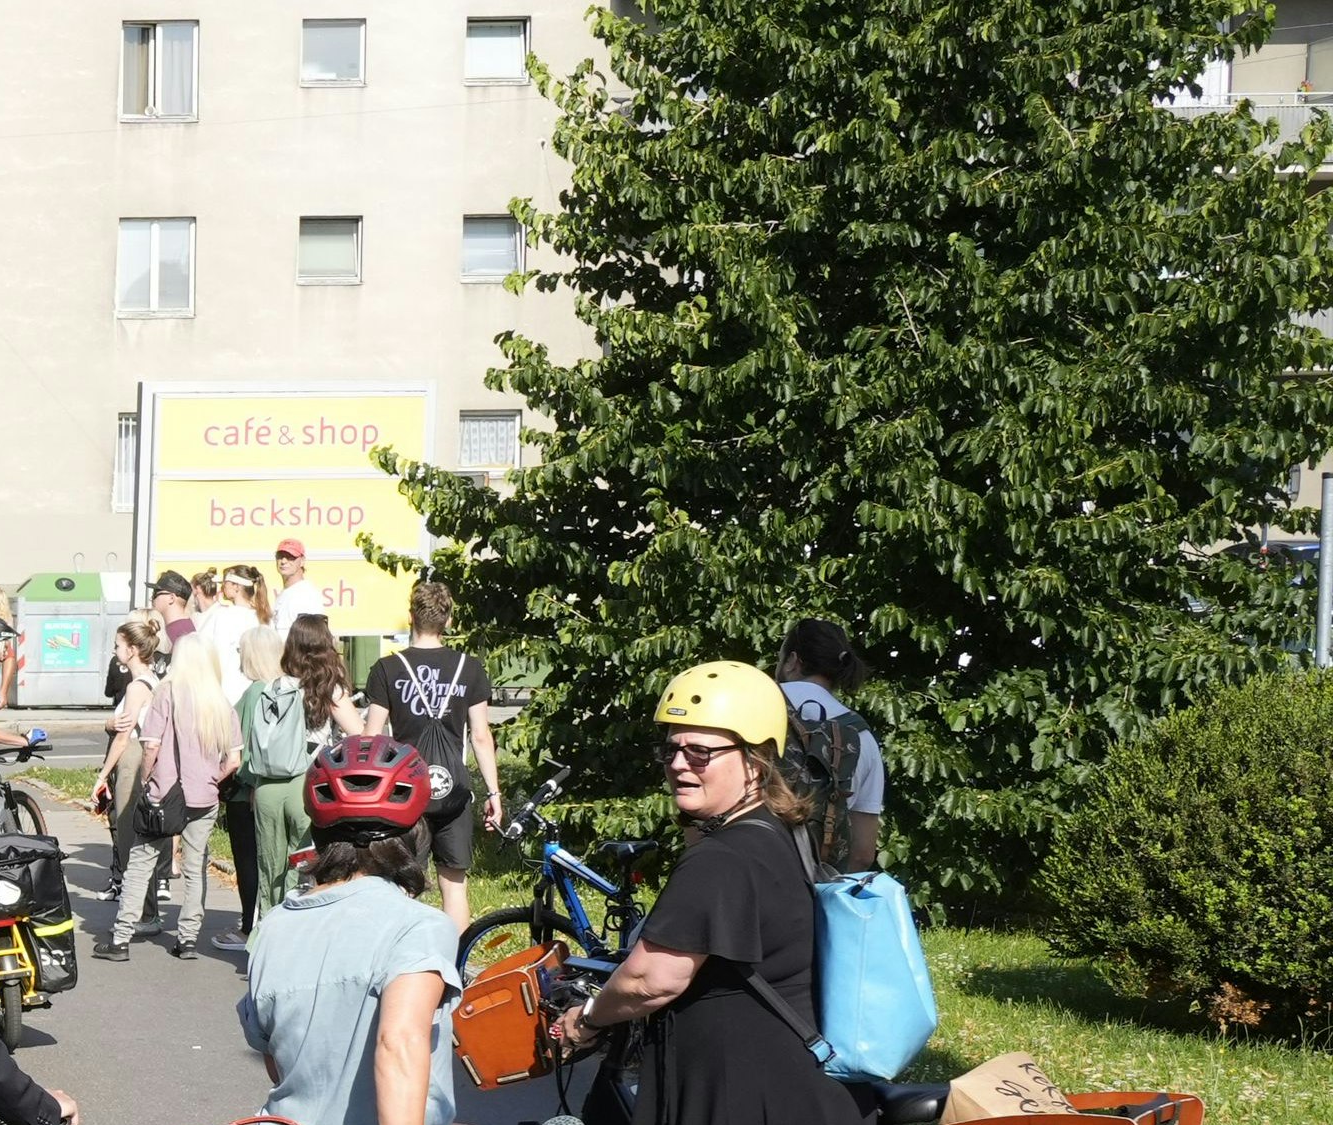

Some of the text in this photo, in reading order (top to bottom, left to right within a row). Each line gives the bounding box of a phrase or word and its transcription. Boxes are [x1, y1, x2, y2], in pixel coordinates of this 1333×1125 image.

[204, 417, 272, 446] café
[302, 416, 379, 452] shop
[210, 498, 365, 532] backshop
